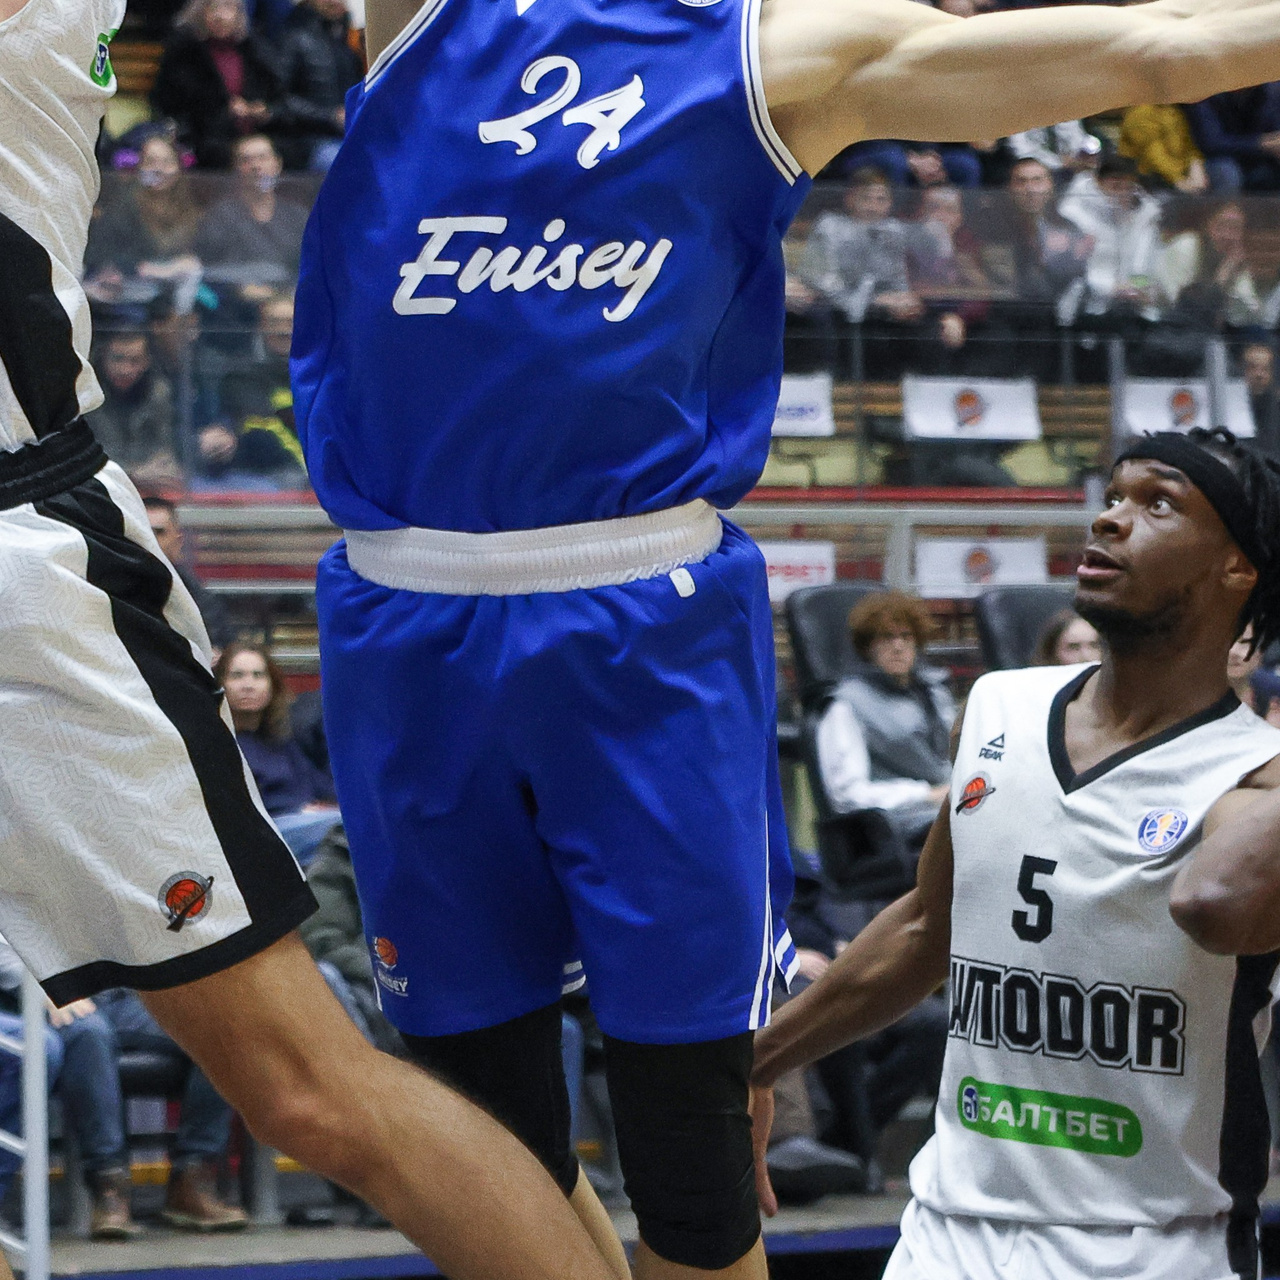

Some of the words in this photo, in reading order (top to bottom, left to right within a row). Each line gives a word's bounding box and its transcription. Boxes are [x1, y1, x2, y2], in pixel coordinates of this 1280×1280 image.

[478, 55, 646, 170] 24
[392, 216, 673, 322] Enisey
[979, 747, 1005, 761] PEAK
[1011, 854, 1058, 943] 5
[978, 1096, 1129, 1143] БАЛТБЕТ
